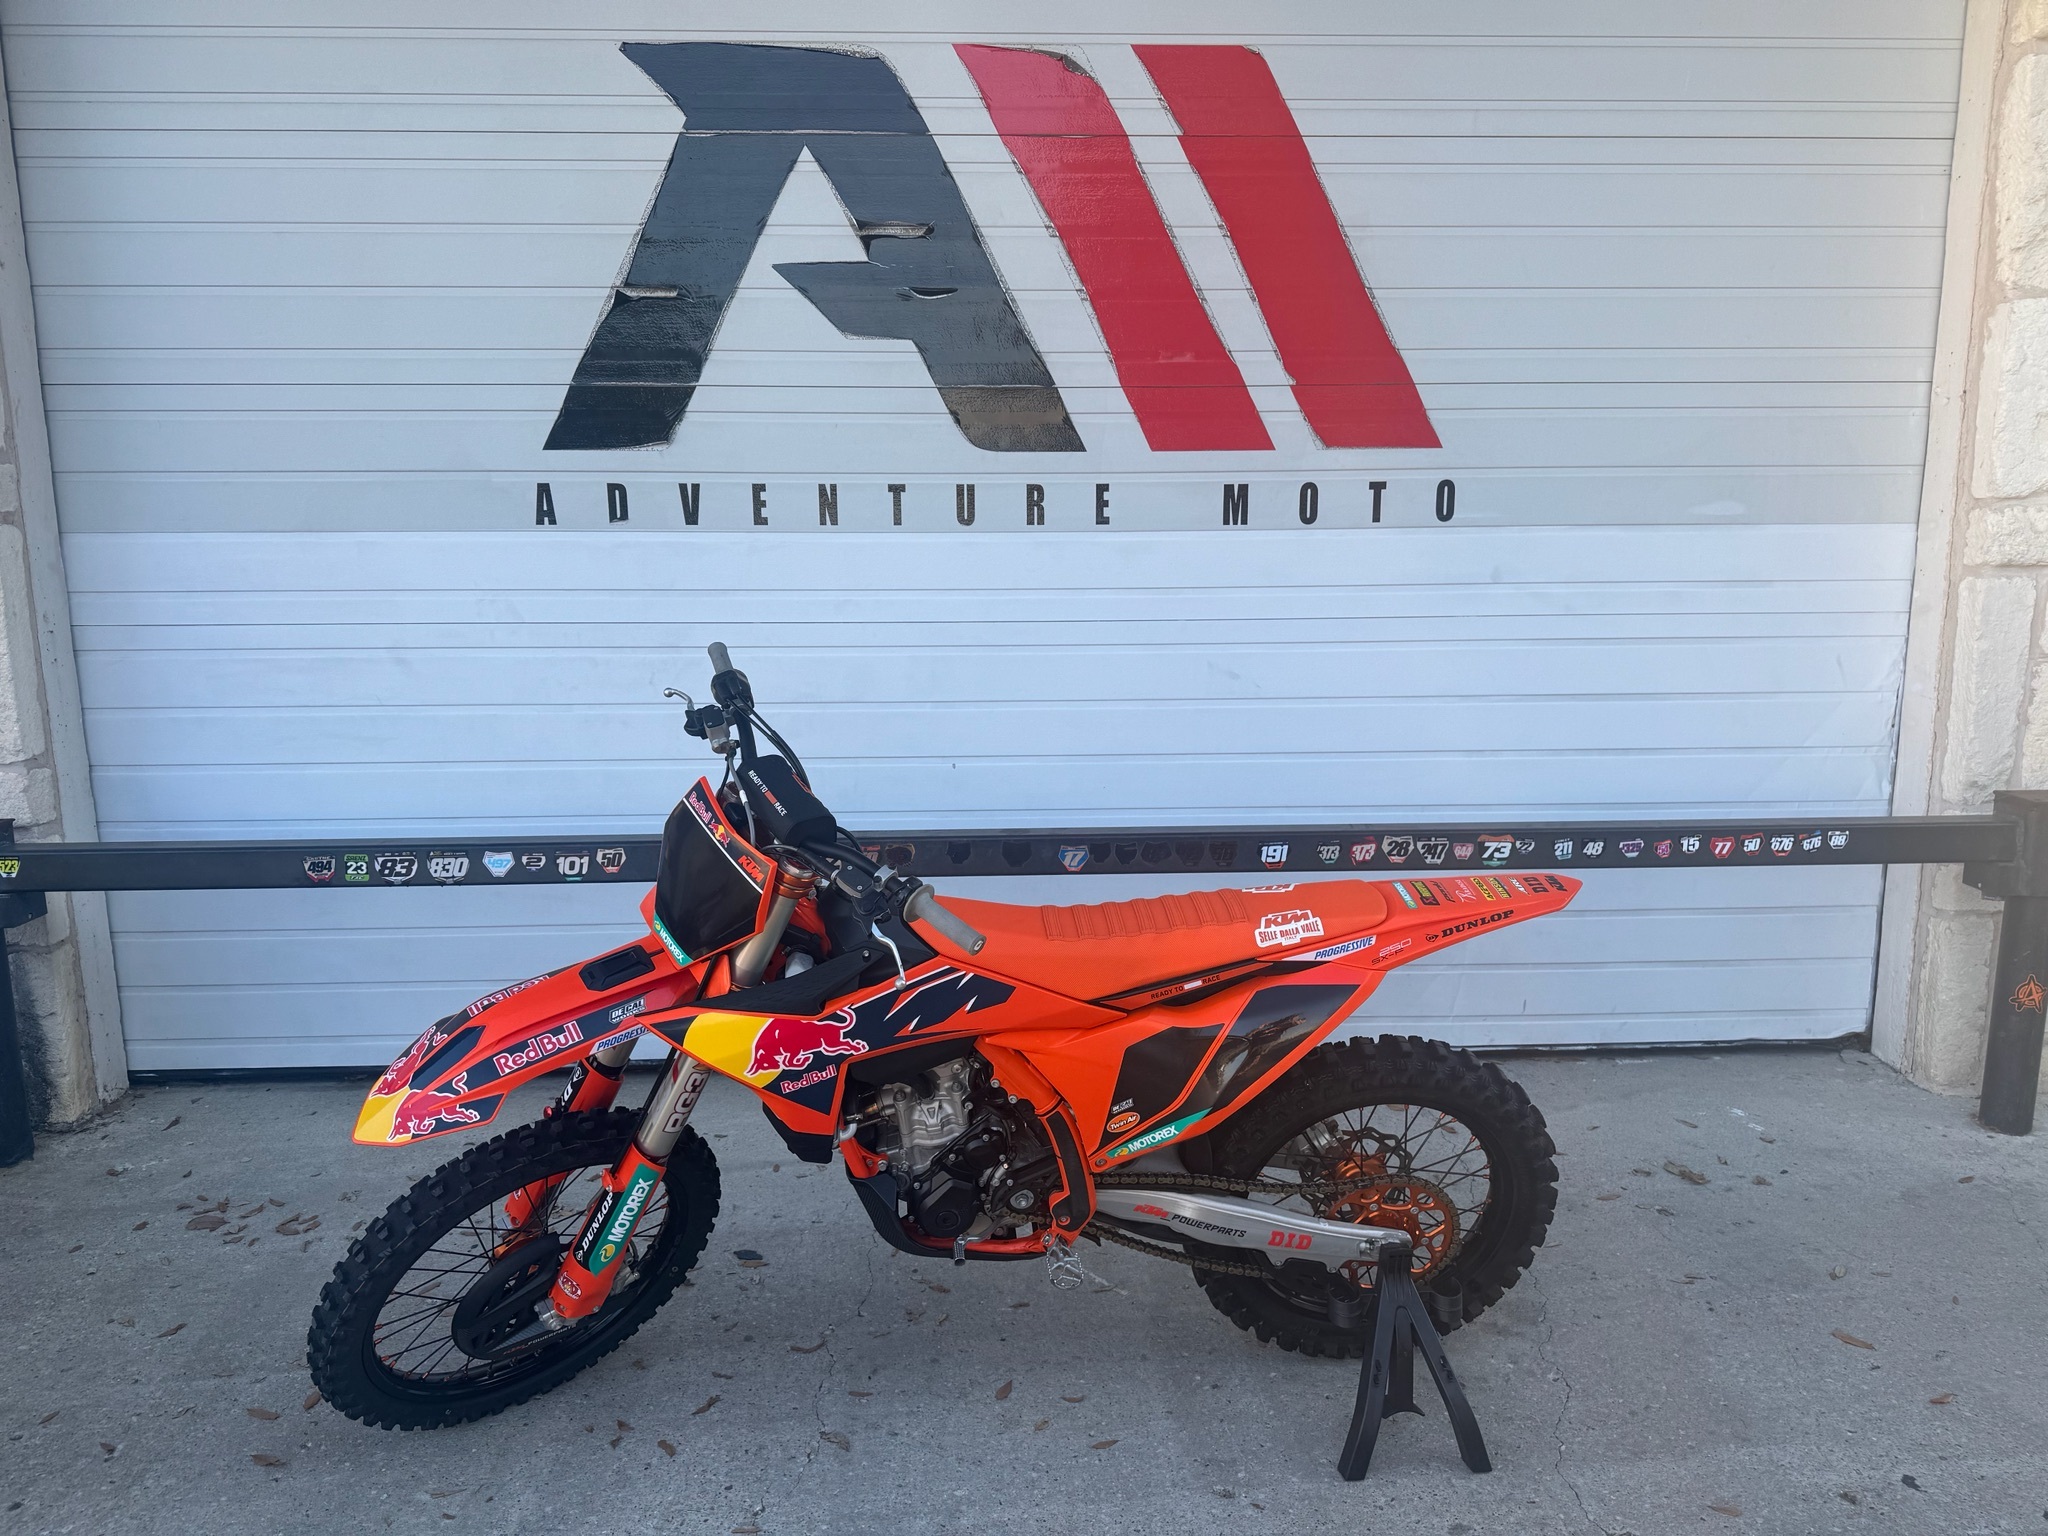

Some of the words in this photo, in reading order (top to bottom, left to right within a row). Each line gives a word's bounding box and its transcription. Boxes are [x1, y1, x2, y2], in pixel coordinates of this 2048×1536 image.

[535, 482, 1110, 526] ADVENTURE
[1222, 479, 1456, 526] MOTO
[748, 770, 764, 787] READY
[760, 785, 769, 793] TO
[774, 802, 788, 817] RACE
[689, 791, 703, 810] Red
[699, 802, 713, 824] Bull
[1260, 844, 1289, 863] 191
[1318, 845, 1340, 860] 373
[1352, 843, 1376, 861] 373
[1386, 840, 1411, 858] 28
[1421, 842, 1447, 861] 247
[1482, 841, 1512, 859] 73
[1554, 841, 1573, 856] 211
[1582, 841, 1605, 855] 48
[1680, 836, 1701, 852] 15
[1714, 842, 1732, 854] 77
[1743, 838, 1761, 852] 50
[307, 860, 333, 873] 494
[346, 861, 367, 874] 23
[380, 857, 416, 877] 83
[429, 857, 469, 877] 830
[487, 858, 512, 868] 497
[525, 856, 543, 867] 2
[556, 856, 590, 875] 101
[601, 852, 623, 868] 50
[738, 855, 765, 882] KTM
[1264, 910, 1312, 929] KTM
[1441, 909, 1515, 939] DUNLOP
[1258, 930, 1278, 943] SELLE
[1279, 926, 1300, 938] DALLA
[1301, 921, 1321, 933] VALLE
[659, 927, 685, 963] MOTOREX
[1314, 936, 1374, 960] PROGRESSIVE
[1379, 937, 1412, 957] 250
[1150, 988, 1173, 1000] READY
[1175, 985, 1184, 993] TO
[1202, 974, 1220, 985] RACE
[611, 998, 644, 1019] DECAL
[493, 1038, 542, 1076] Red
[537, 1021, 584, 1055] Bull
[780, 1073, 810, 1094] Red
[809, 1064, 837, 1084] Bull
[663, 1071, 710, 1134] RG3
[1111, 1119, 1127, 1130] Twin
[1127, 1114, 1137, 1123] Air
[1127, 1124, 1179, 1152] MOTOREX
[607, 1178, 654, 1242] MOTOREX
[581, 1191, 615, 1252] DUNLOP
[1133, 1203, 1169, 1219] KTM
[1171, 1213, 1247, 1239] POWERPARTS
